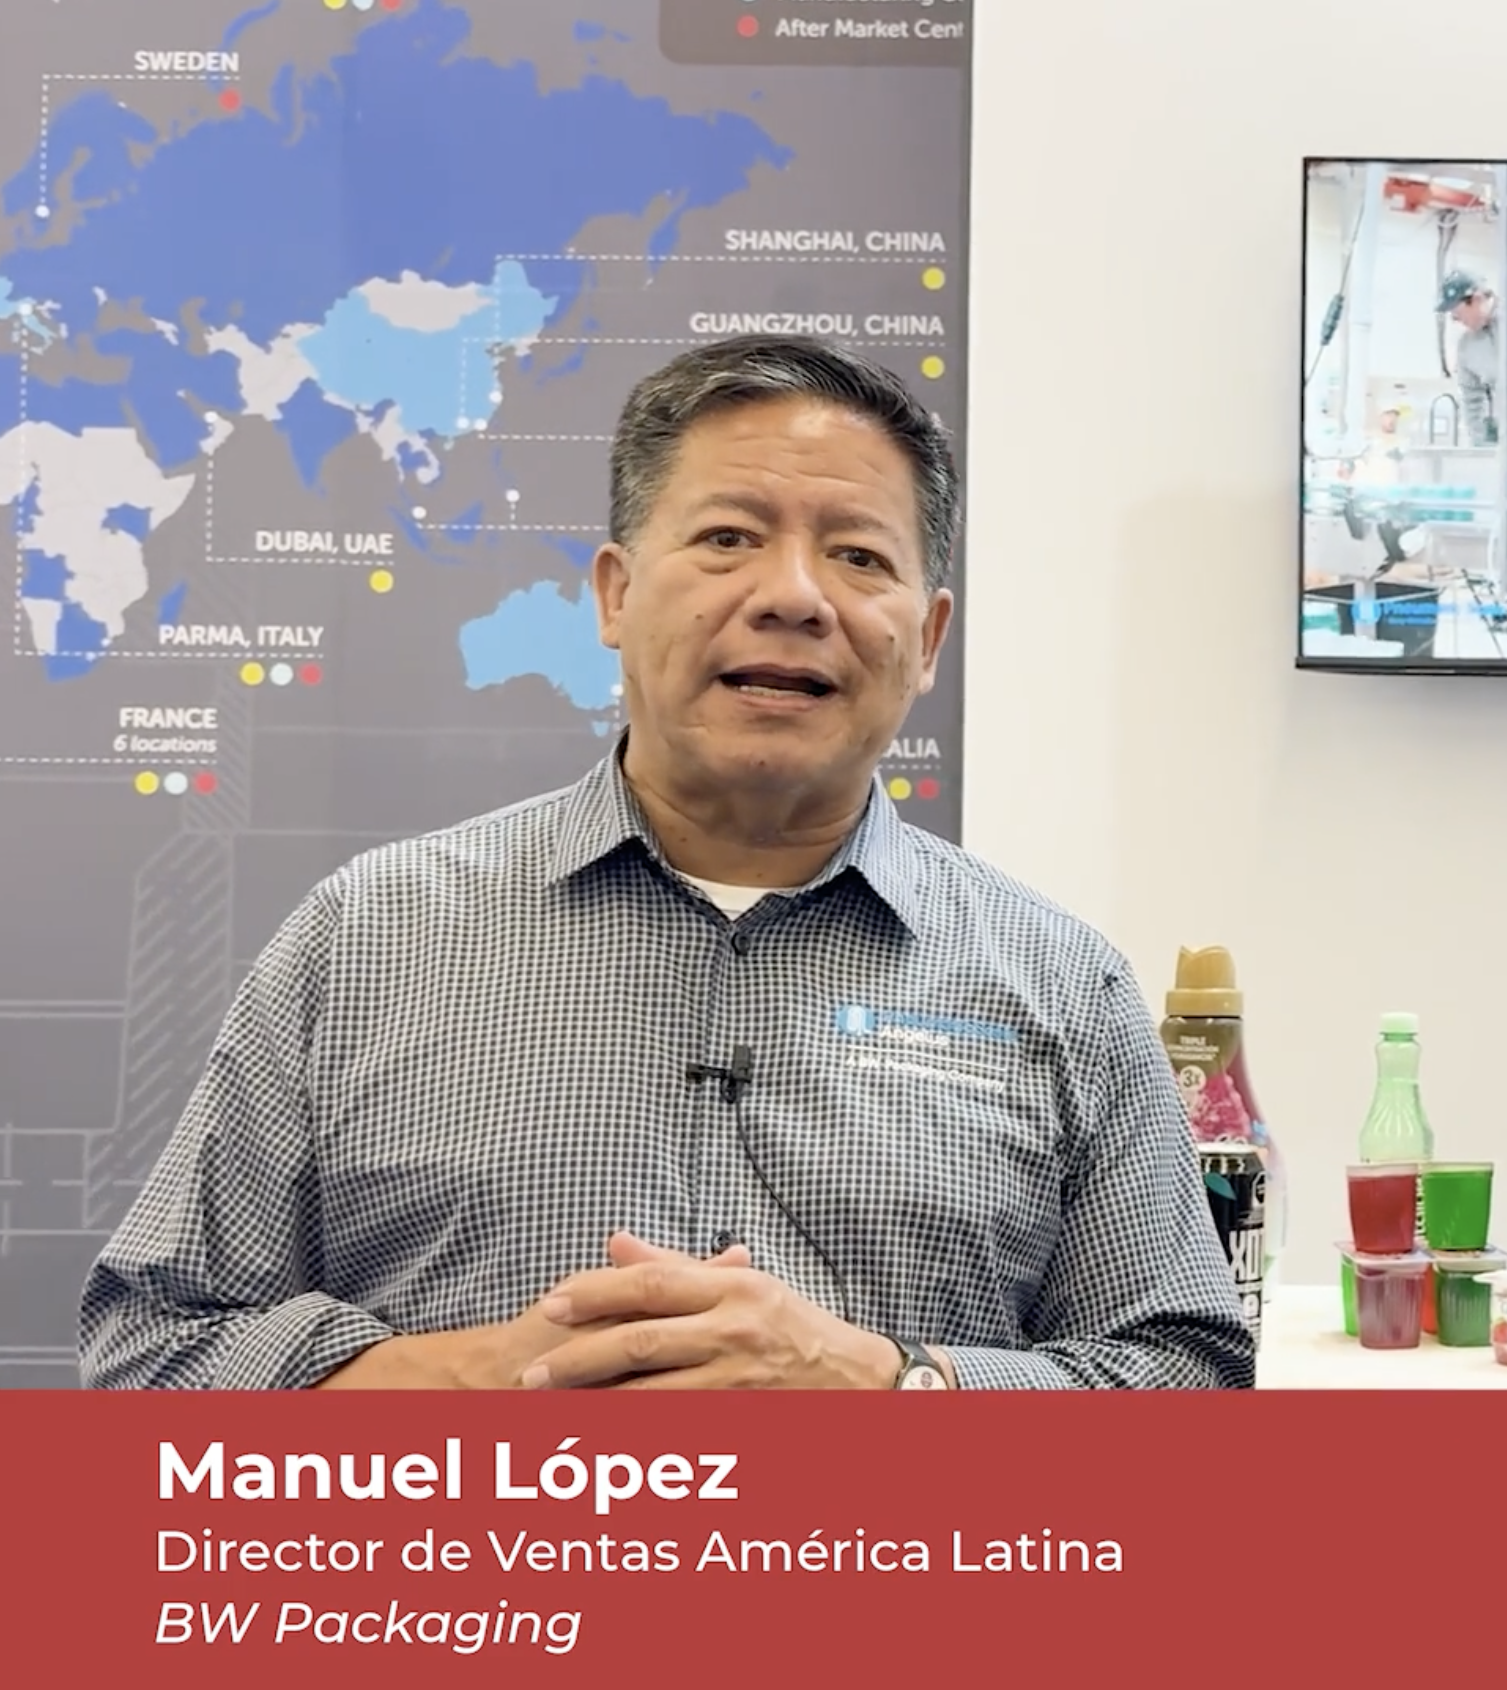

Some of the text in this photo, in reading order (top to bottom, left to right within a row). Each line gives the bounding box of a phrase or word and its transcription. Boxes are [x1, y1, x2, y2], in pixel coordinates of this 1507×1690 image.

[775, 18, 830, 38] After
[834, 18, 909, 38] Market
[134, 51, 239, 71] SWEDEN
[725, 229, 945, 253] SHANGHAI, CHINA
[689, 312, 944, 337] GUANGZHOU, CHINA
[255, 530, 394, 555] DUBAI, UAE
[159, 624, 324, 649] PARMA, ITALY
[119, 707, 218, 729] FRANCE
[113, 734, 217, 753] 6 locations
[883, 738, 941, 759] ALIA
